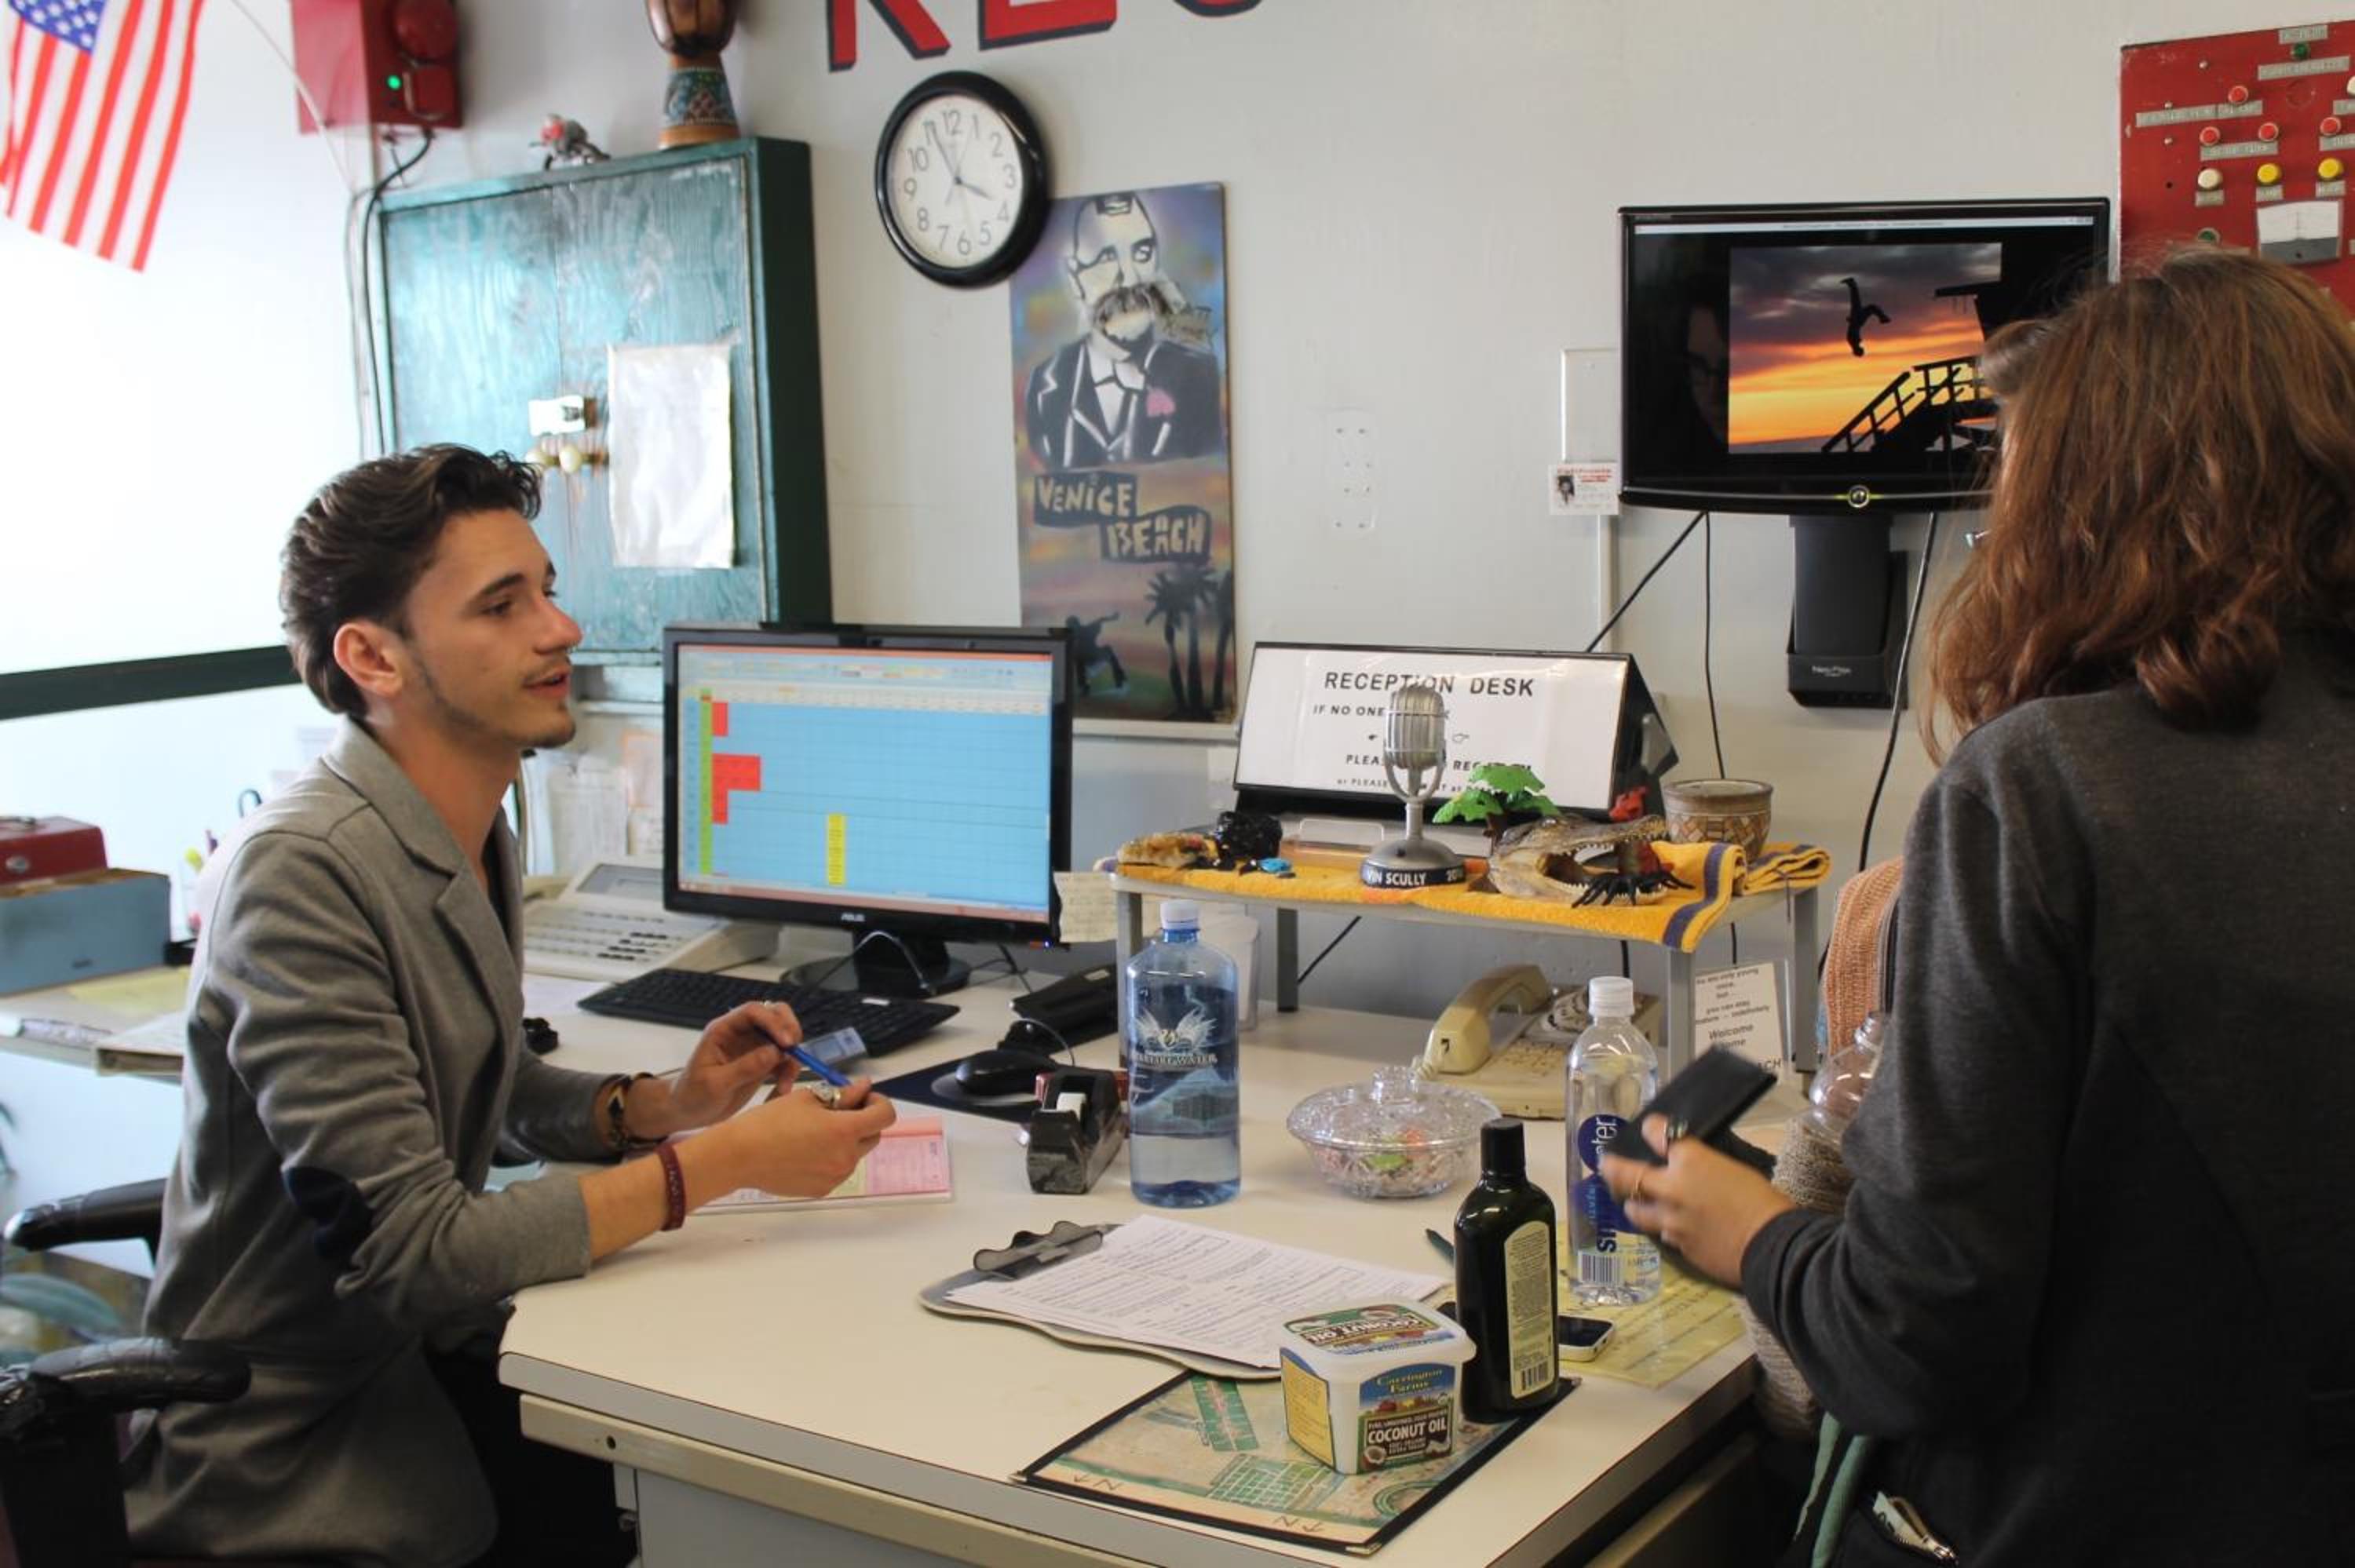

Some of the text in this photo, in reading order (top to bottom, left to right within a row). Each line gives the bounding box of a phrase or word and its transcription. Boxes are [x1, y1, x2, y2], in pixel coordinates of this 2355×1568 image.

[943, 109, 962, 136] 12
[973, 114, 980, 140] 1
[990, 132, 1004, 158] 2
[908, 147, 929, 173] 10
[1002, 164, 1016, 189] 3
[904, 177, 918, 202] 9
[916, 207, 929, 232] 8
[996, 202, 1010, 223] 4
[937, 225, 949, 249] 7
[957, 232, 971, 256] 6
[979, 221, 991, 246] 5
[1108, 512, 1205, 558] BEACH
[1470, 677, 1535, 697] DESK
[1313, 705, 1385, 717] IF NO ONE
[1385, 872, 1427, 886] SCULLY
[1709, 1024, 1754, 1040] Welcome
[1367, 1416, 1447, 1444] COCONUT OIL
